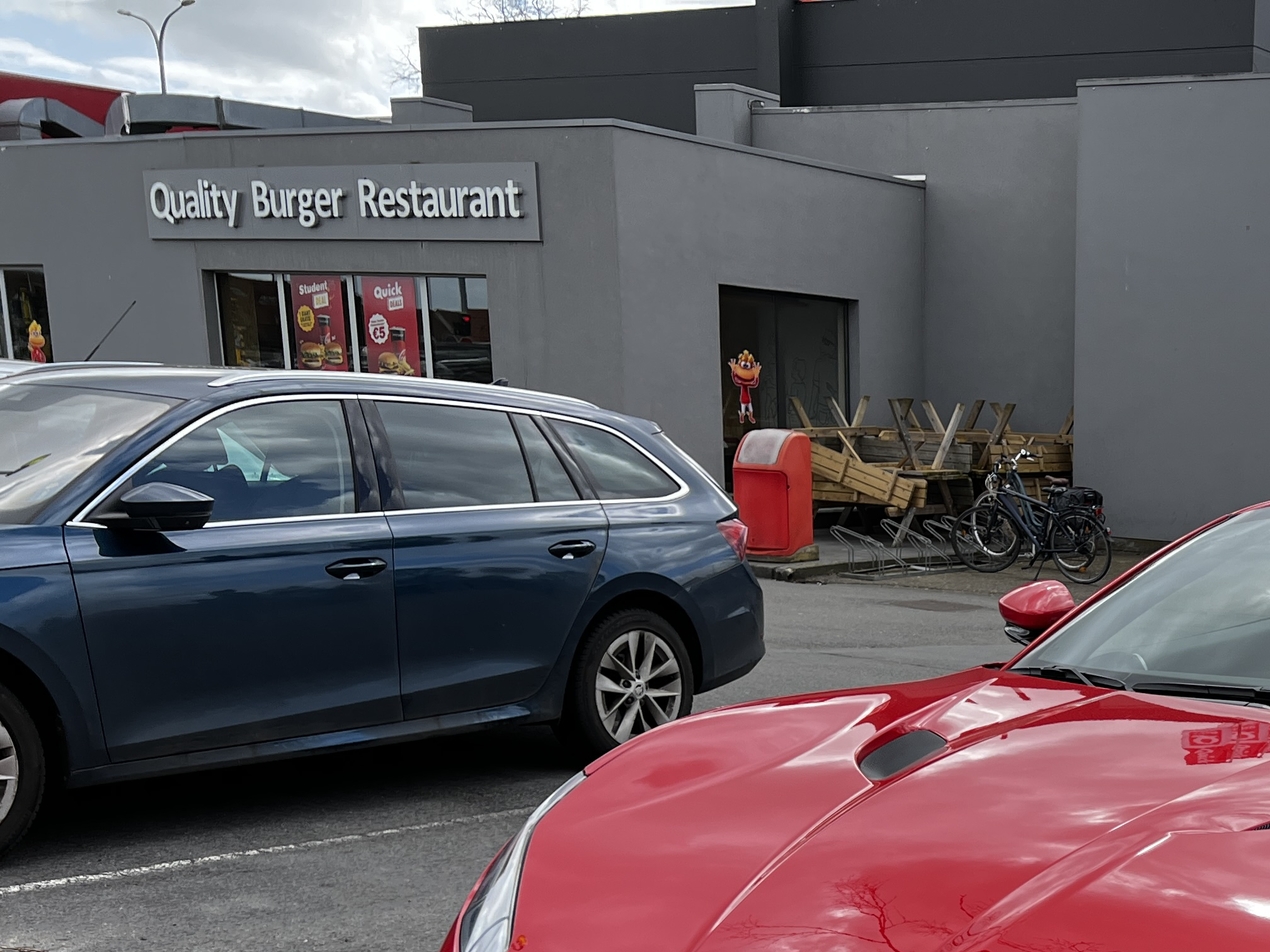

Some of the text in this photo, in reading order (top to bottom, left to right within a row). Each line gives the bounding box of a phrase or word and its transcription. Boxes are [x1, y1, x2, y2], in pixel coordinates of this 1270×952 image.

[149, 178, 523, 228] Quality Burger Restaurant
[299, 281, 328, 295] Student
[374, 282, 402, 299] Quick
[315, 295, 327, 306] DEAL
[389, 299, 403, 309] DEALS
[372, 326, 386, 340] €5
